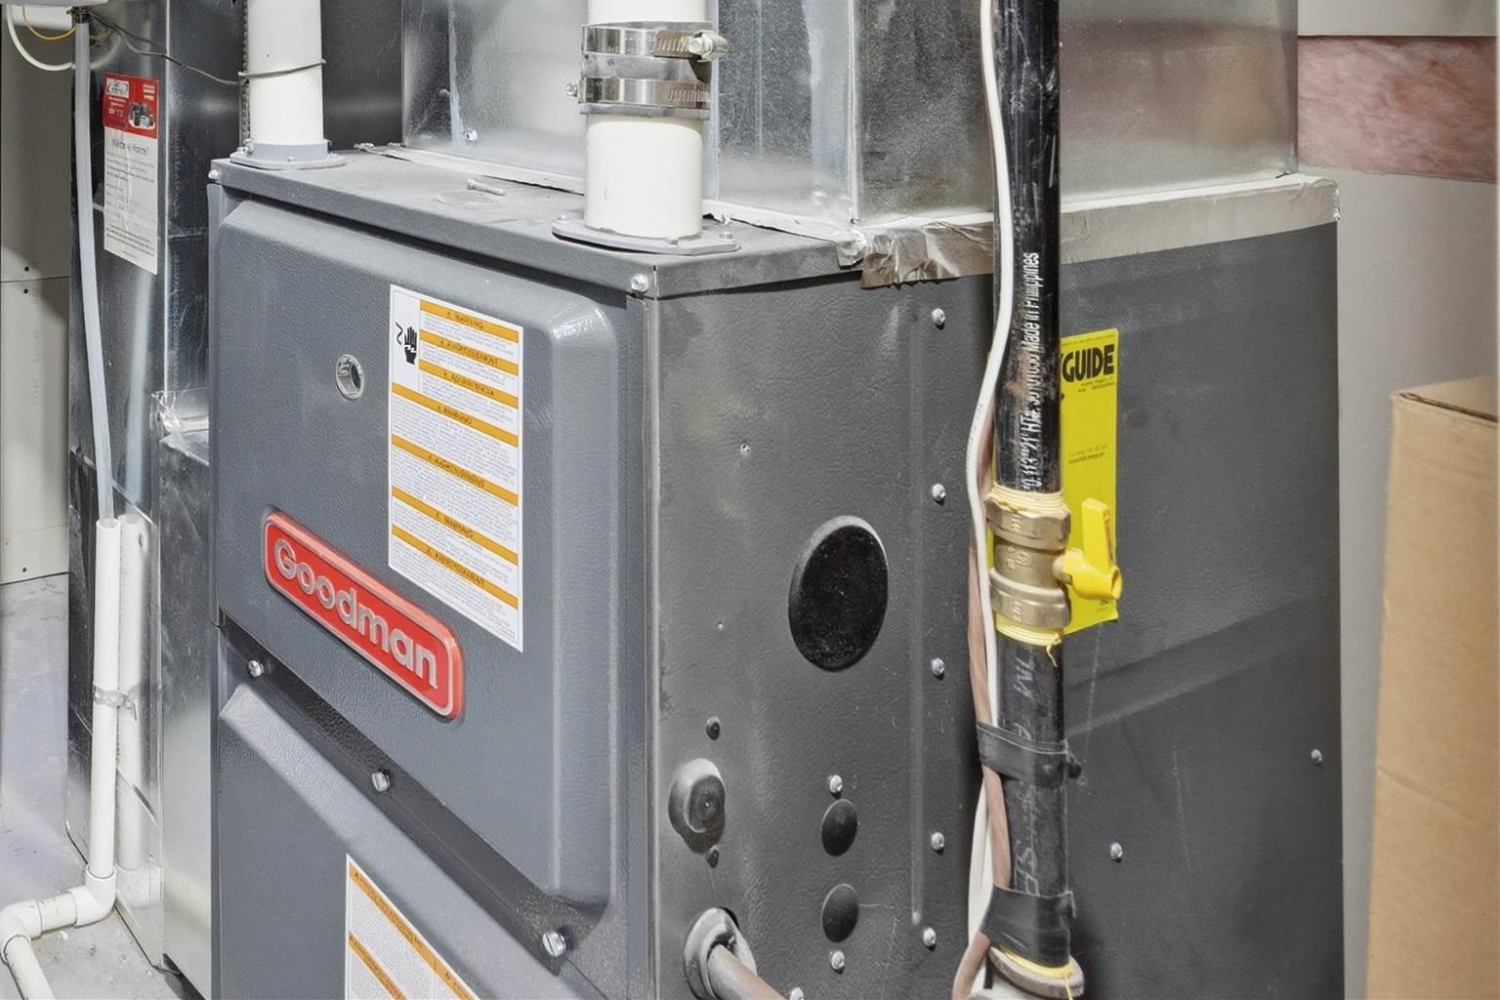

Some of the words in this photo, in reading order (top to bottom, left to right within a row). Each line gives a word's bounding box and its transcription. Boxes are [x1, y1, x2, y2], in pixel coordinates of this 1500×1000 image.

[1020, 321, 1043, 352] Made
[1061, 343, 1115, 383] GUIDE
[274, 538, 438, 690] Goodman
